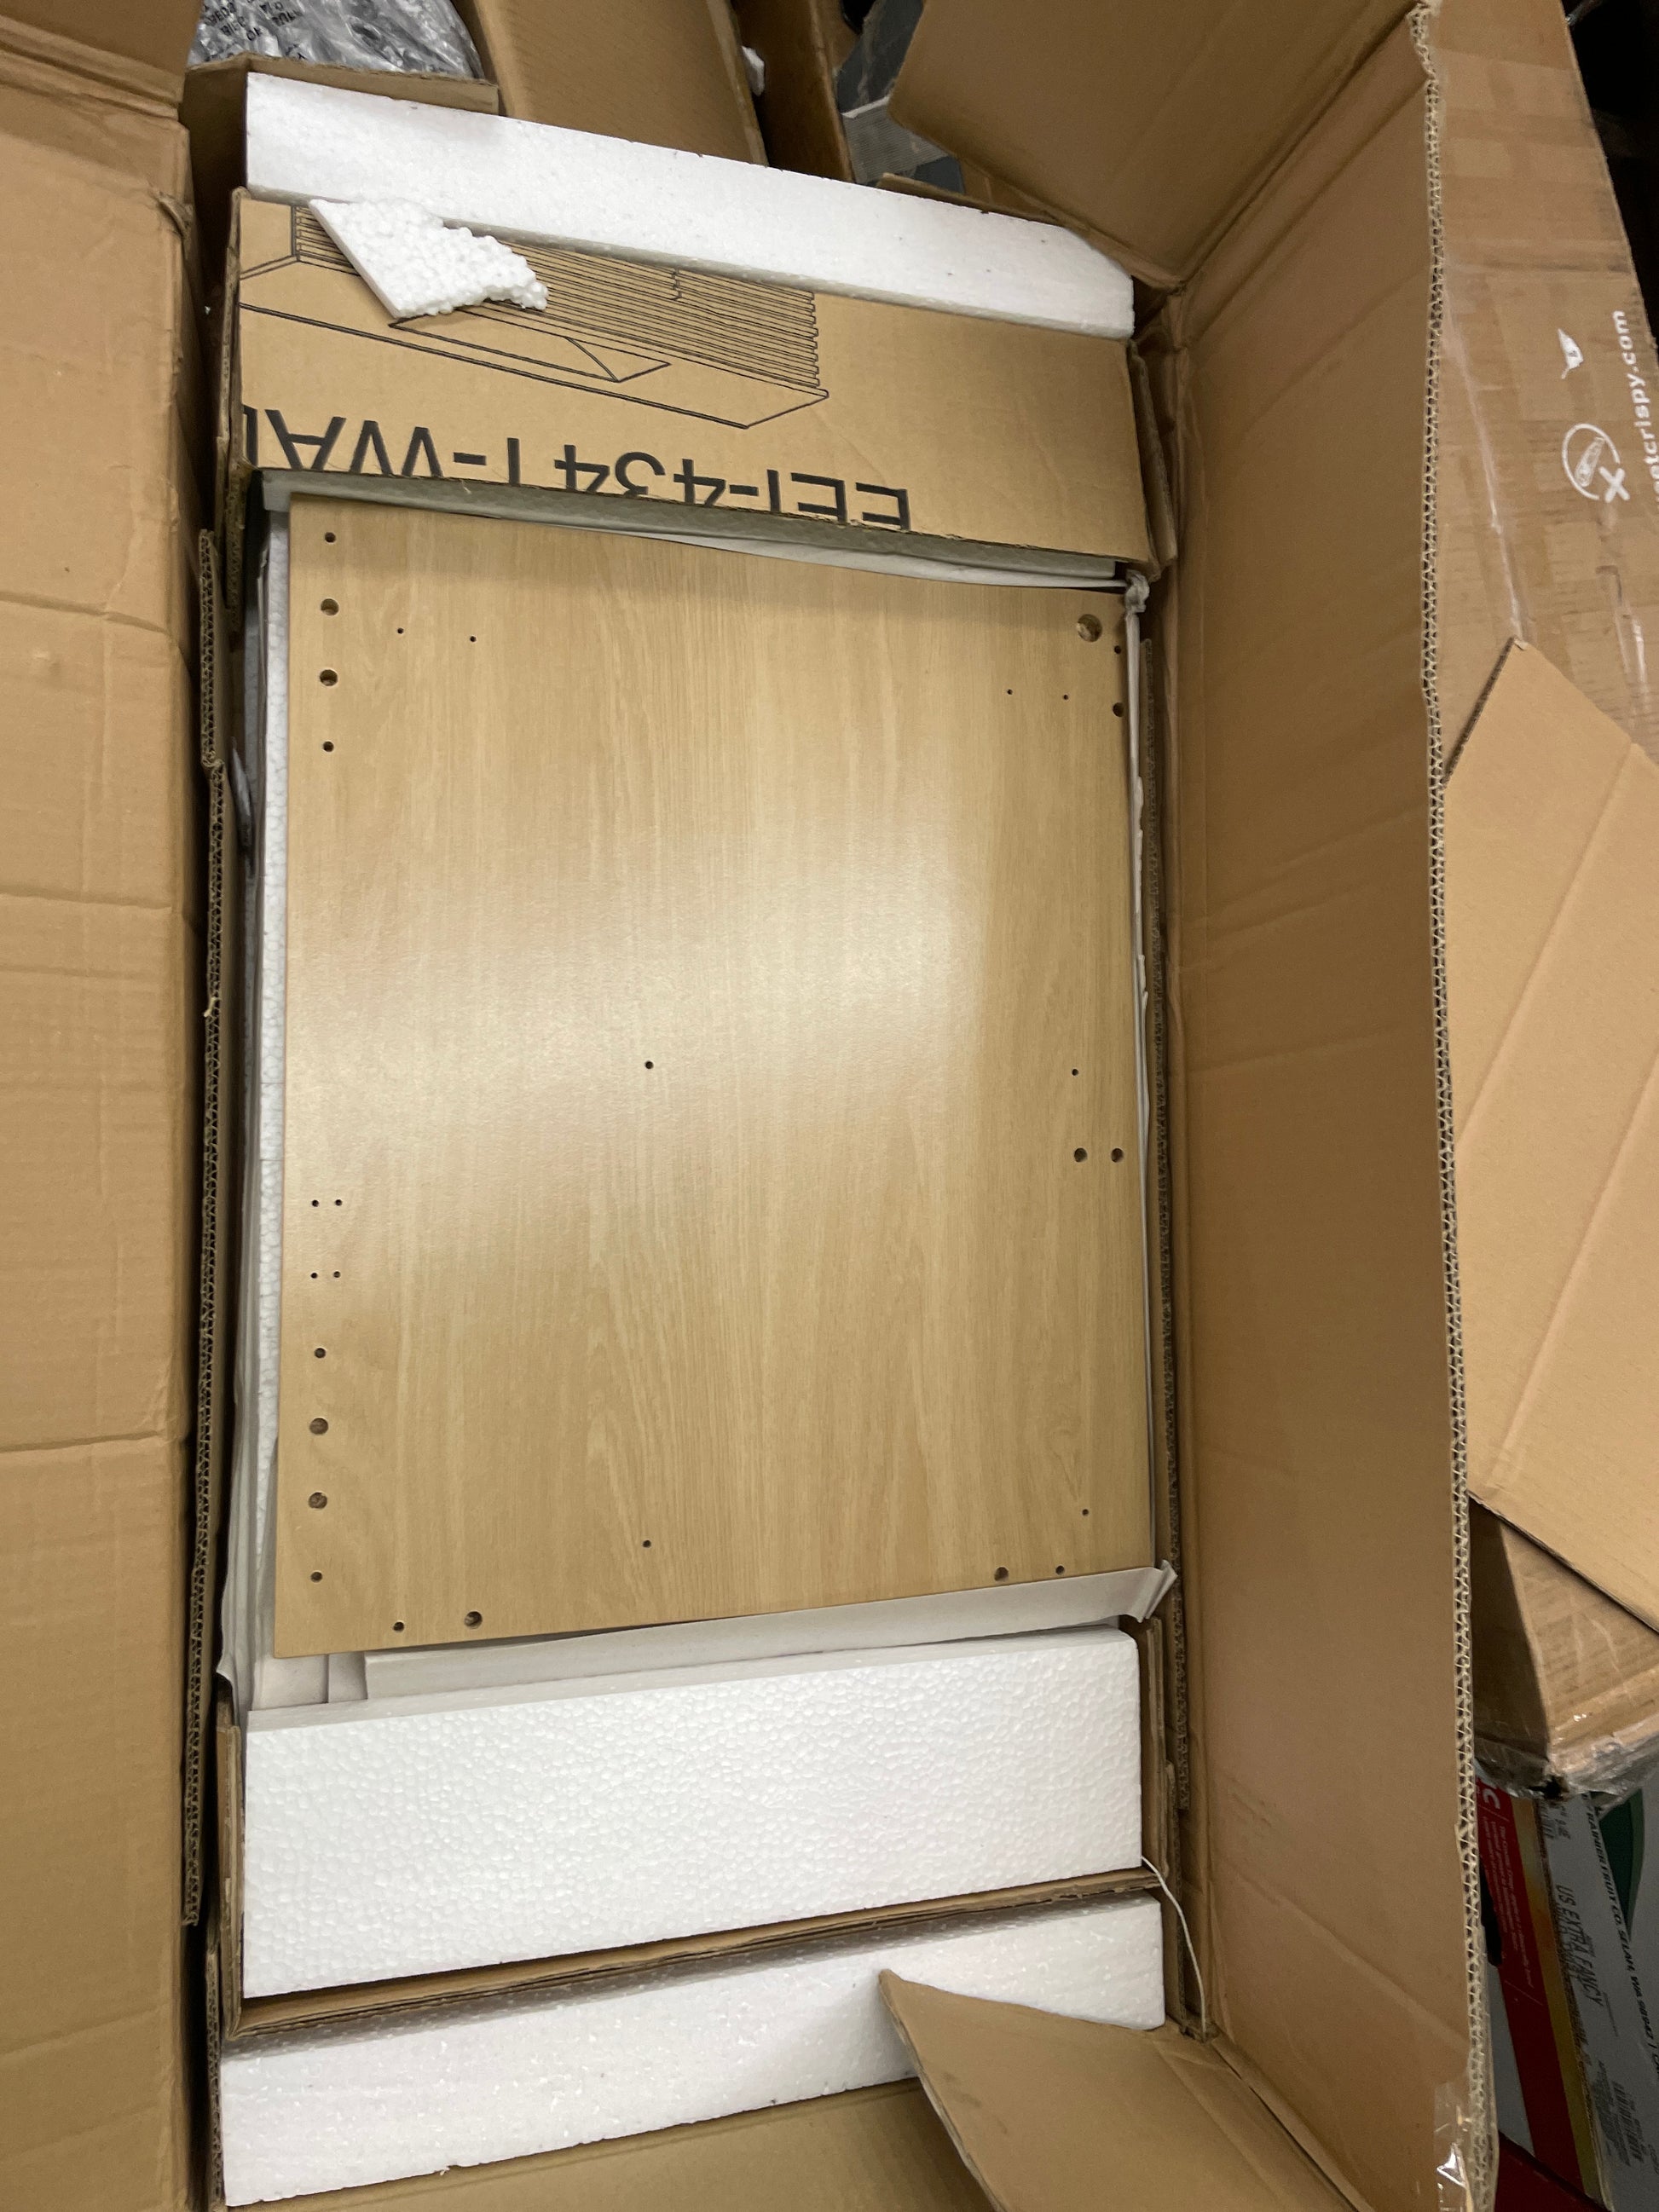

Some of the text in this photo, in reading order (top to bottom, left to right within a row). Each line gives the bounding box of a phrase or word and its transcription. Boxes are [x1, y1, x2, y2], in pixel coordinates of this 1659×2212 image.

[1556, 1884, 1604, 2007] US EXTRA FANCY
